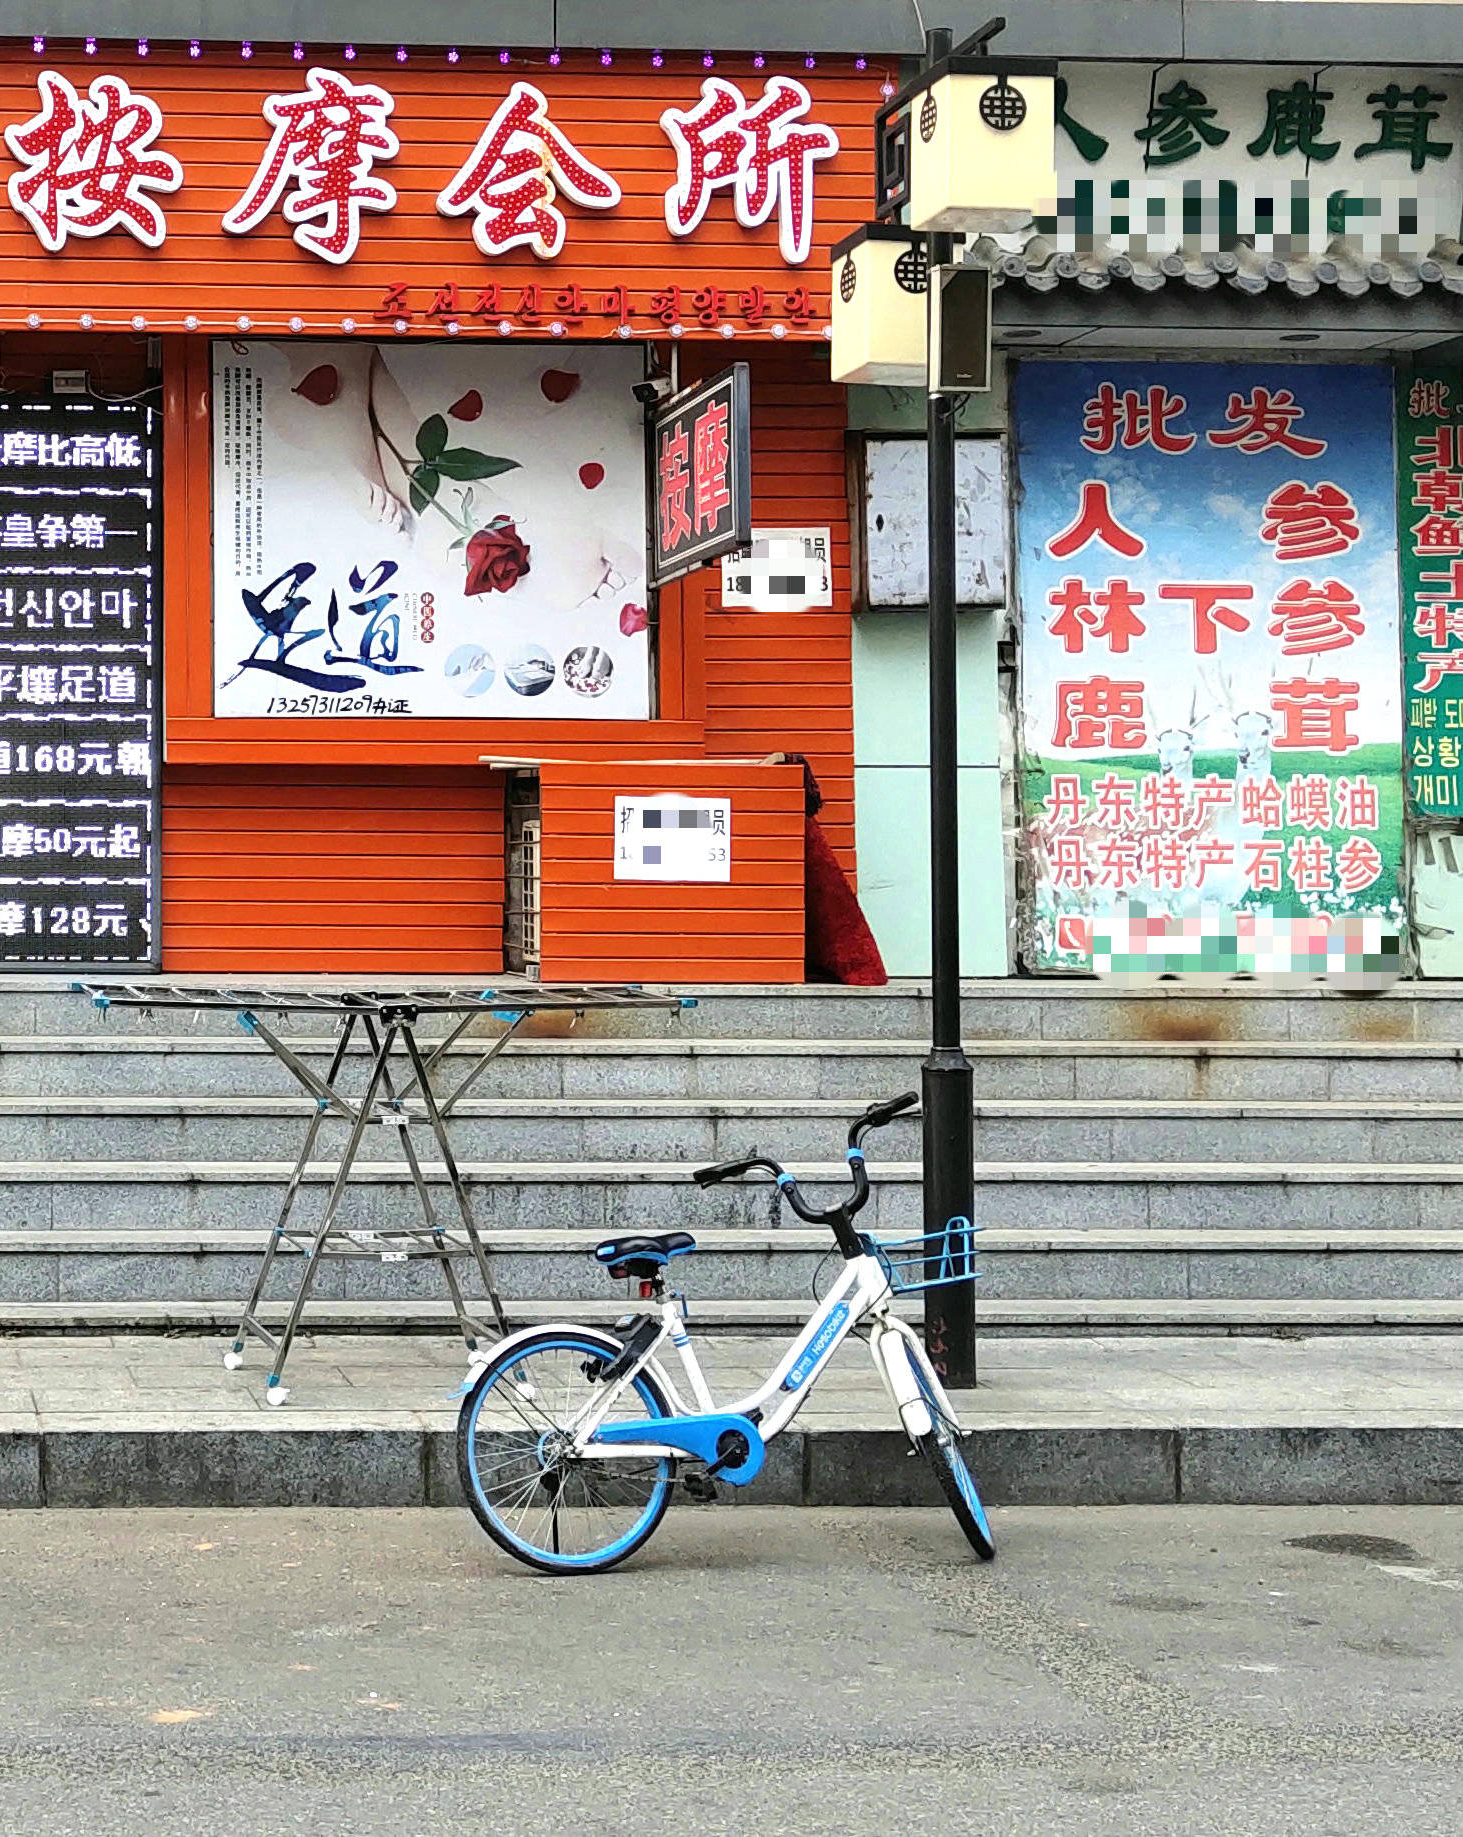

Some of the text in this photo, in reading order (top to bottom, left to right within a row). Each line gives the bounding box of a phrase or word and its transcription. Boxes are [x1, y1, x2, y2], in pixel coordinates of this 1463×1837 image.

[373, 281, 832, 327] 조선전신안마평양발안
[1079, 381, 1327, 459] 批发
[1408, 378, 1463, 418] 批
[659, 400, 730, 552] 按摩
[1046, 480, 1361, 561] 人参
[219, 560, 425, 693] 足道
[1046, 576, 1366, 656] 林下参
[1050, 675, 1361, 756] 鹿茸
[1044, 773, 1380, 832] 丹东特产蛤蟆油
[1049, 833, 1383, 893] 丹东特产石柱参
